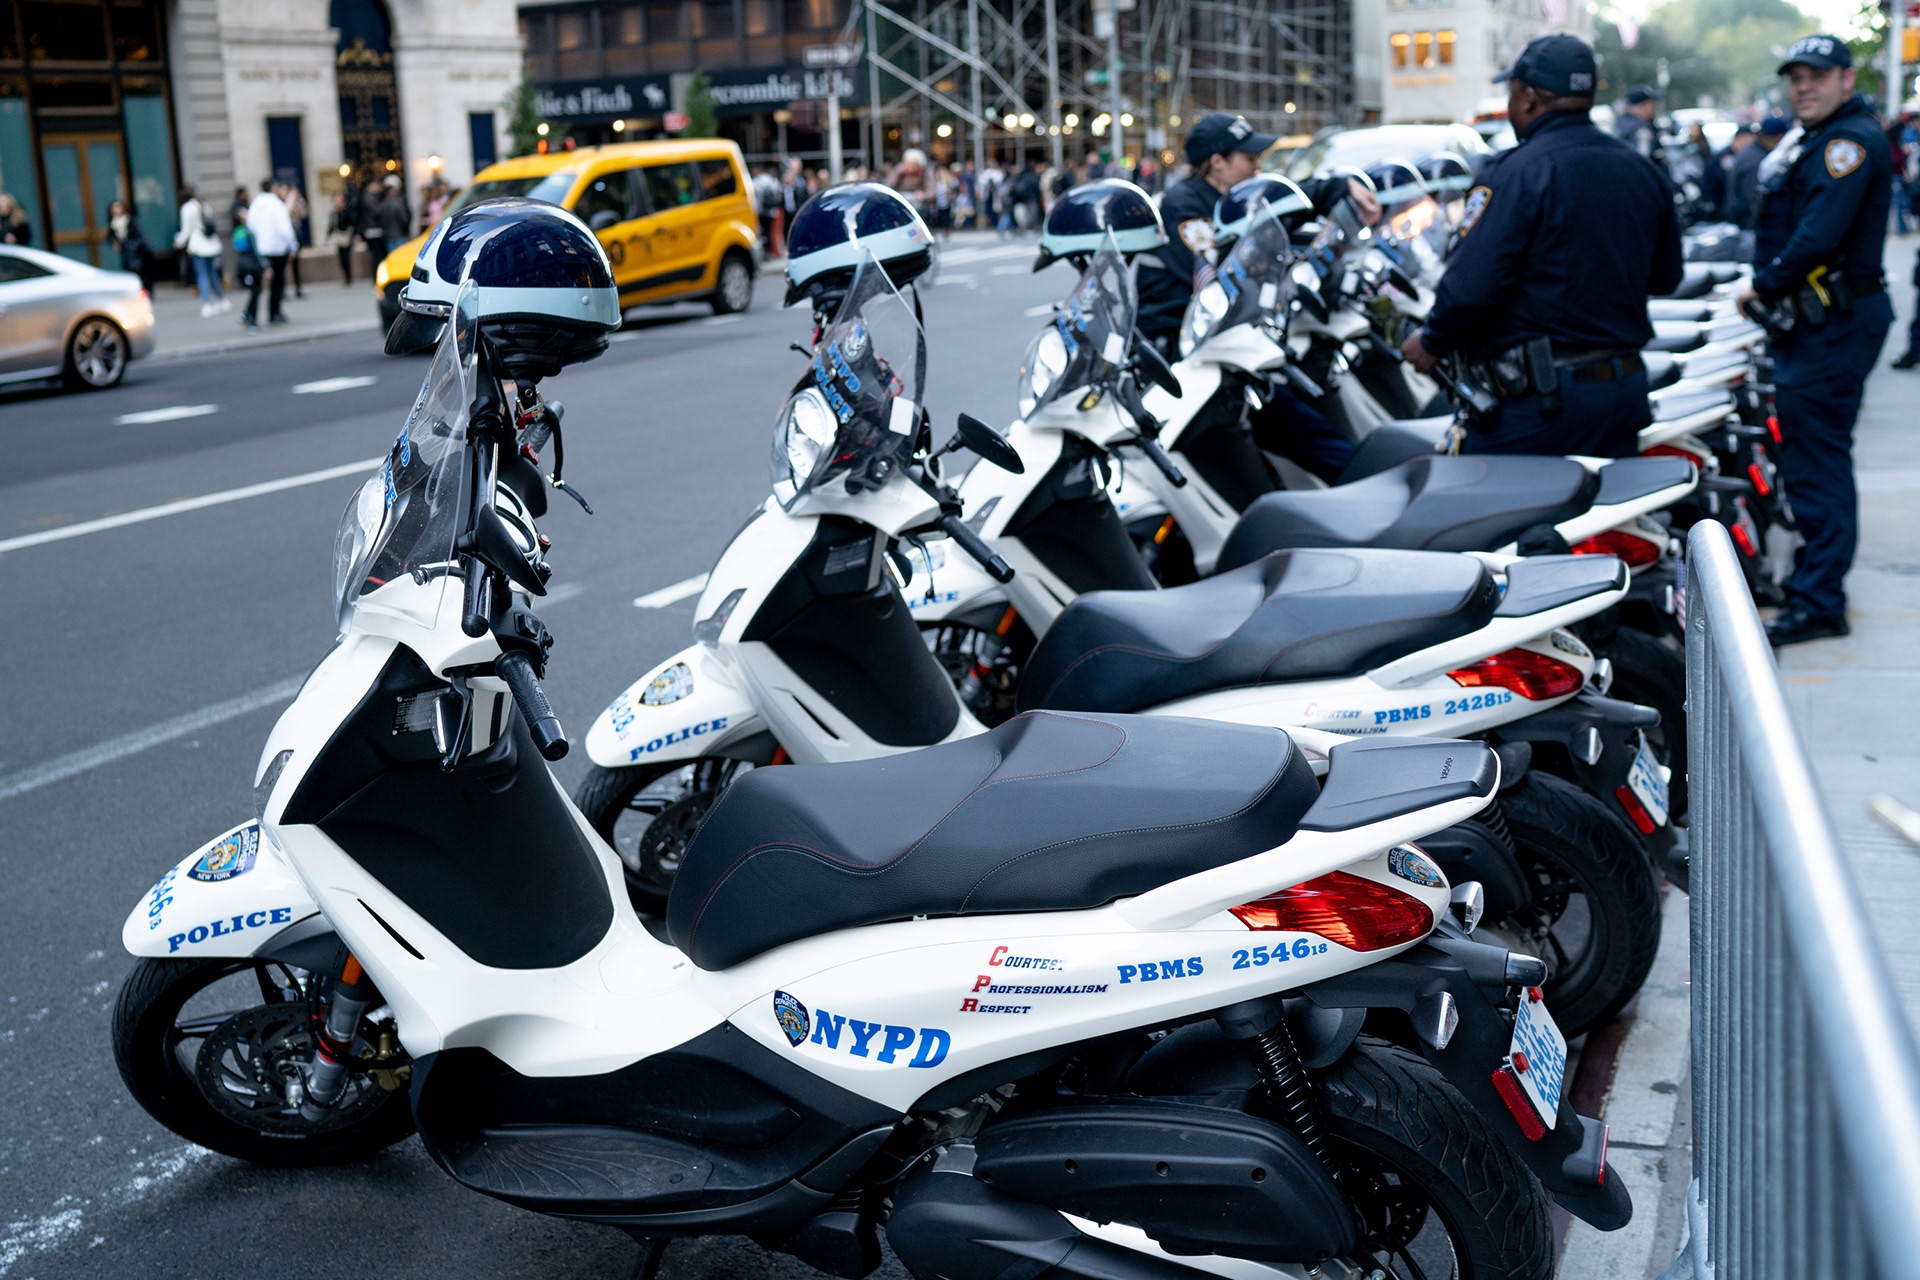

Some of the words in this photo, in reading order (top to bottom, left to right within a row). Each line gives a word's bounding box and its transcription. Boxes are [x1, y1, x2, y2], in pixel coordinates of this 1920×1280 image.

[1374, 705, 1432, 725] PBMS
[630, 717, 728, 762] POLICE
[167, 907, 292, 953] POLICE
[972, 974, 1109, 994] PROFESSIONALISM
[1117, 957, 1204, 984] PBMS
[960, 998, 1032, 1014] RESPECT
[1513, 1000, 1531, 1053] NYPD
[810, 1008, 951, 1069] NYPD
[1546, 1045, 1566, 1117] POLICE
